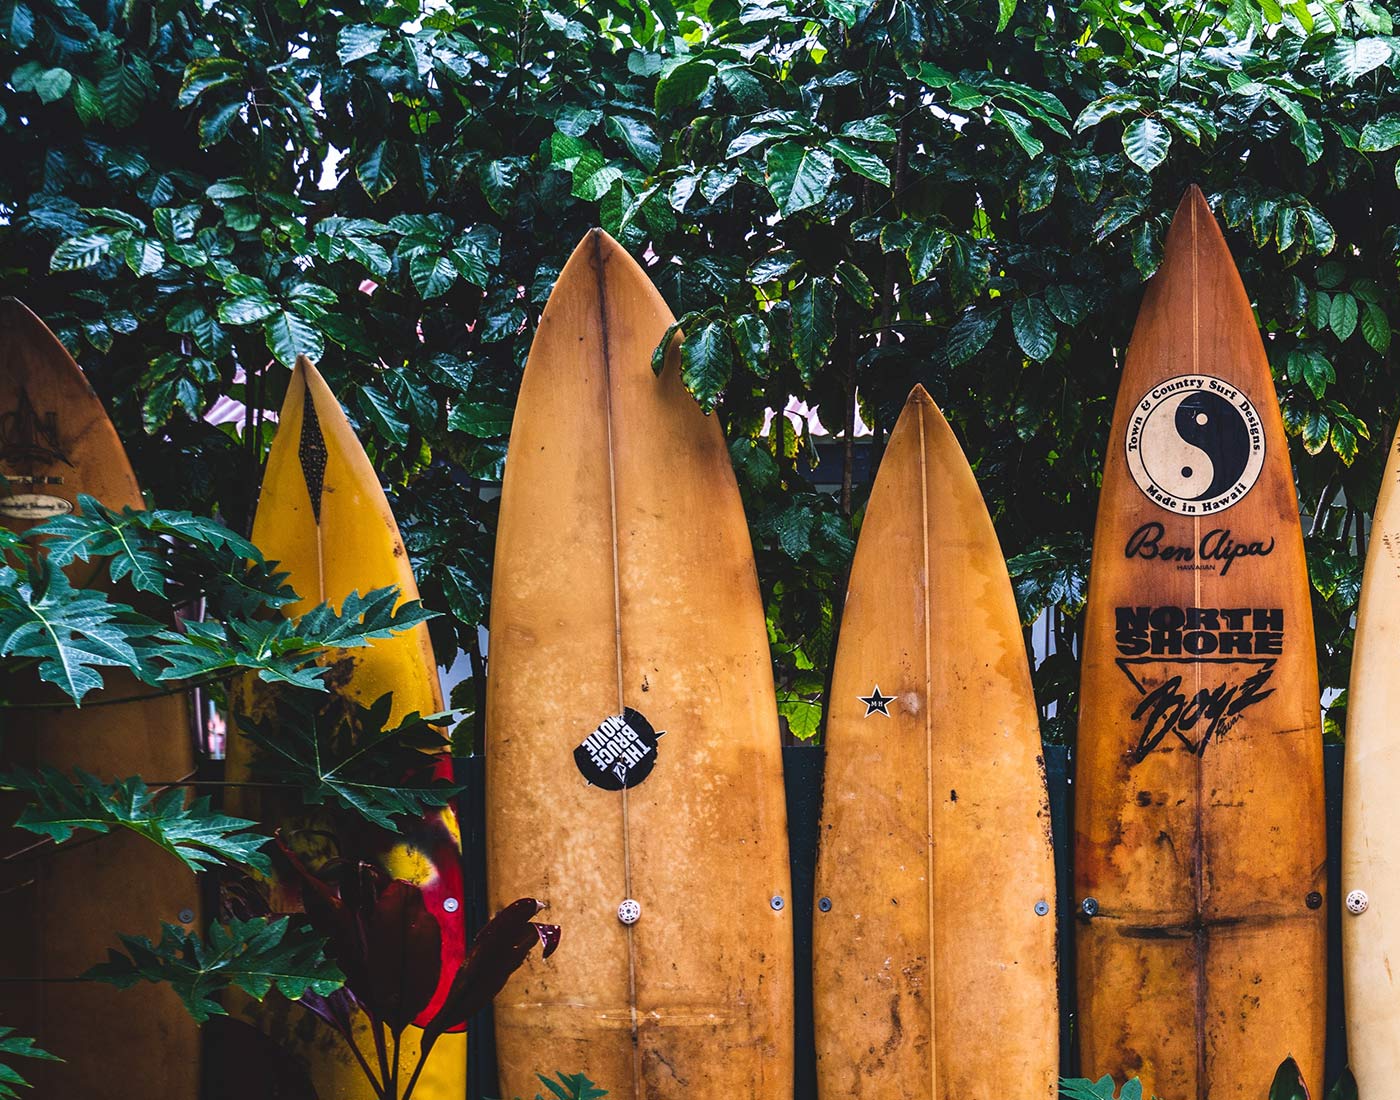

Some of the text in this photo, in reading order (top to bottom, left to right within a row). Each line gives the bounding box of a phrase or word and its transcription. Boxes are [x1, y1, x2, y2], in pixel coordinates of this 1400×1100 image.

[1128, 378, 1261, 452] Town & Country Surf Designs
[1145, 483, 1247, 513] Made in Hawaii
[1124, 521, 1195, 560] Ben
[1115, 606, 1284, 631] NORTH
[1115, 629, 1284, 655] SHORE
[582, 714, 626, 756] MOVIE
[591, 724, 639, 772] BRUCE
[621, 738, 652, 769] THE
